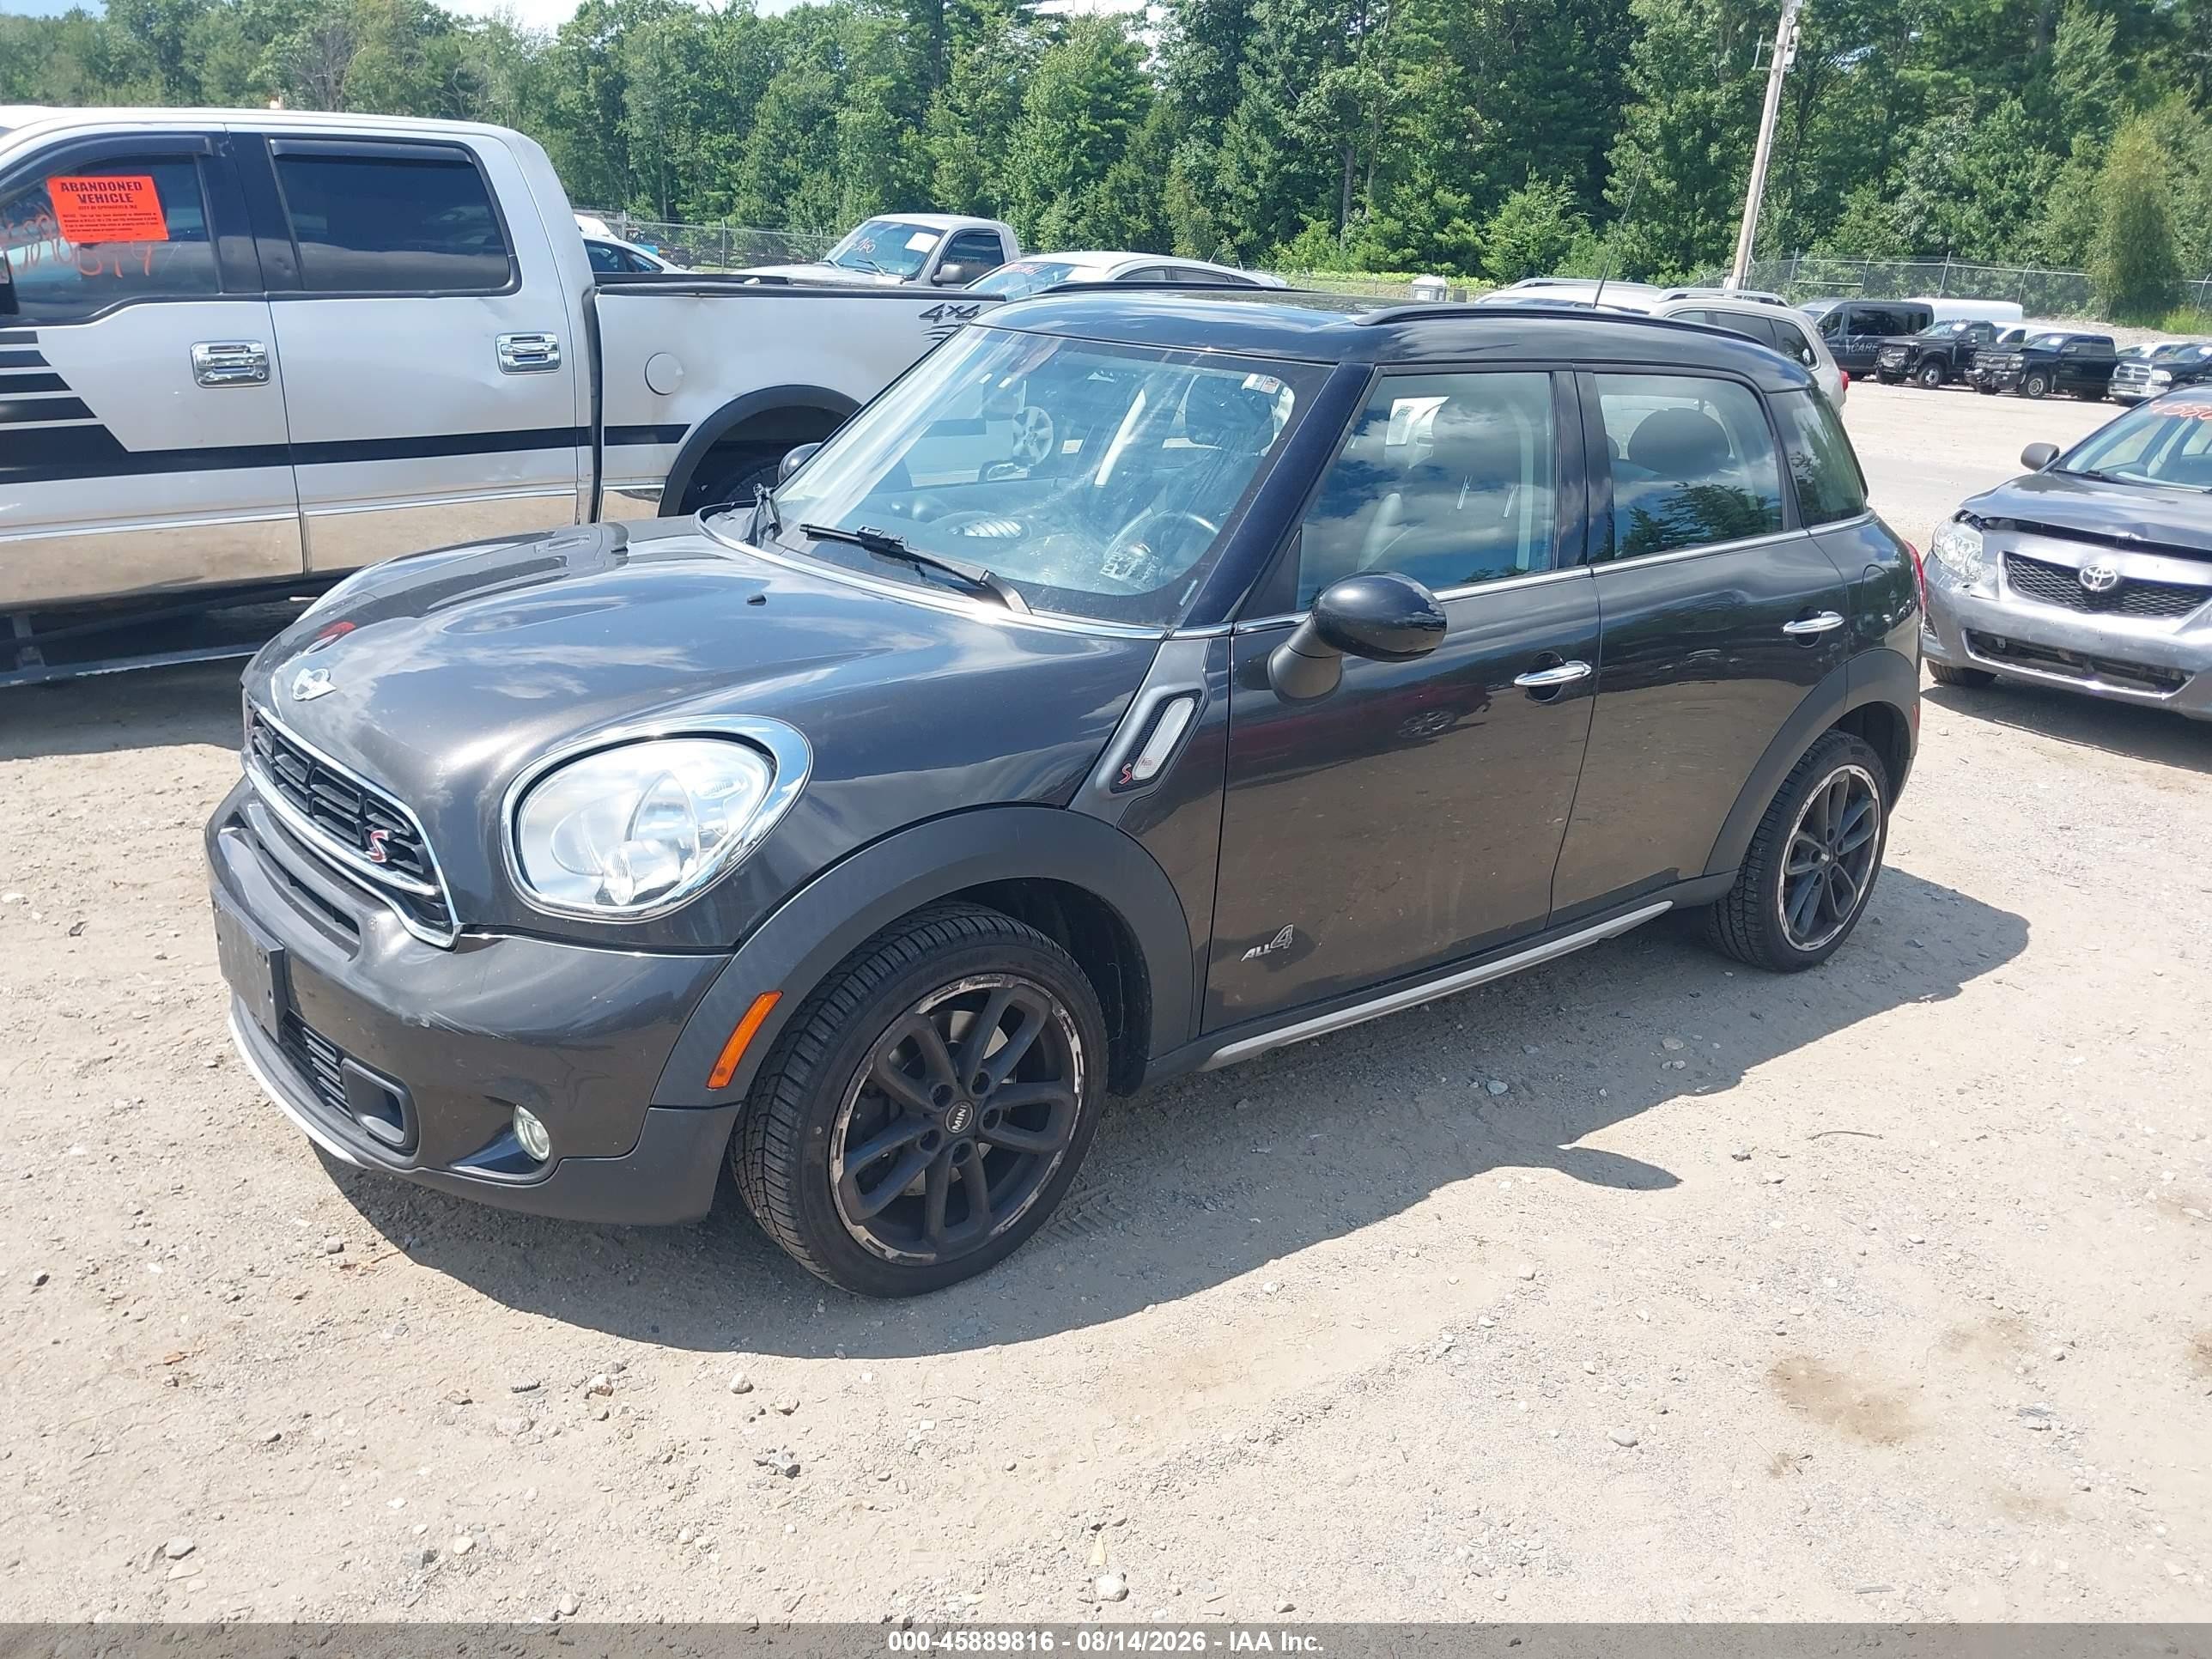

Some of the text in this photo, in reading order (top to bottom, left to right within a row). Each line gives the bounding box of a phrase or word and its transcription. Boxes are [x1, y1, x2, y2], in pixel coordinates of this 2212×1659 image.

[60, 181, 143, 192] ABANDONED
[77, 193, 134, 204] VEHICLE
[1118, 763, 1133, 785] S
[365, 830, 389, 863] S
[1240, 923, 1294, 962] ALL4
[951, 1104, 968, 1131] MINI
